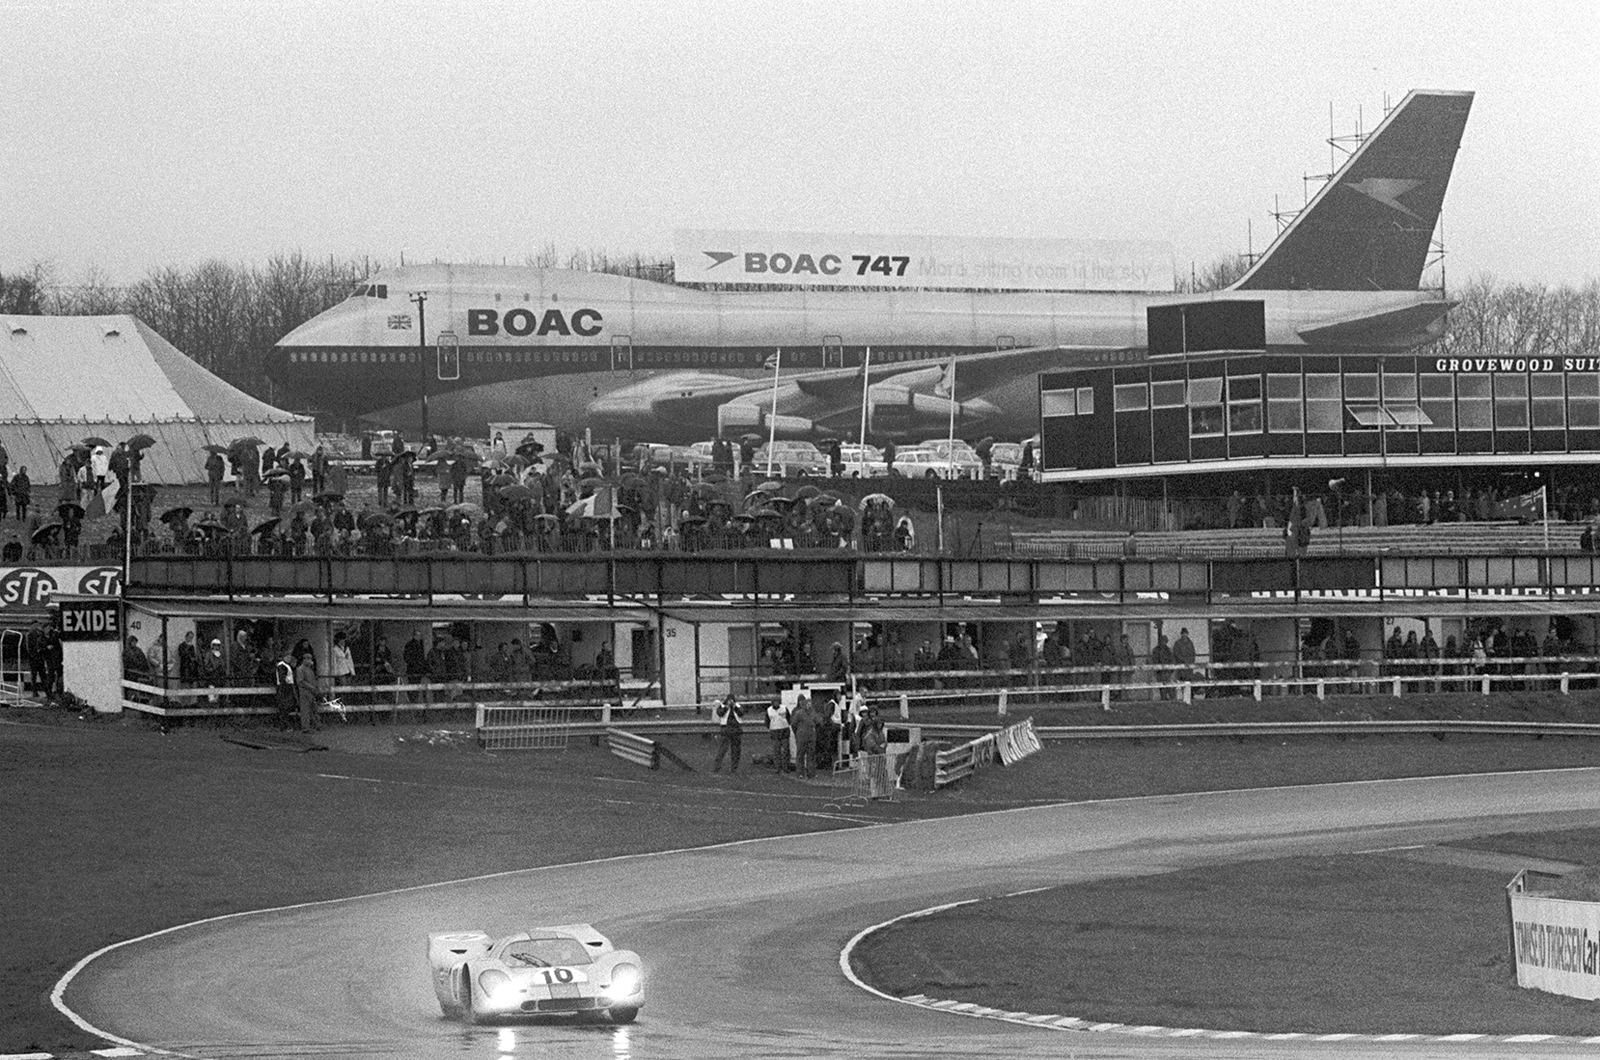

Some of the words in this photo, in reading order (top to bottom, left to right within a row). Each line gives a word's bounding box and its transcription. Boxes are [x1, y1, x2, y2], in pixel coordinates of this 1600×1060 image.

[745, 252, 842, 275] BOAC
[852, 255, 910, 276] 747
[468, 308, 603, 336] BOAC
[1436, 358, 1554, 371] GROVEWOOD
[4, 572, 53, 605] STP
[62, 610, 117, 632] EXIDE
[130, 621, 141, 630] 40
[666, 629, 676, 638] 35
[1583, 928, 1598, 975] Car
[541, 968, 573, 984] 10
